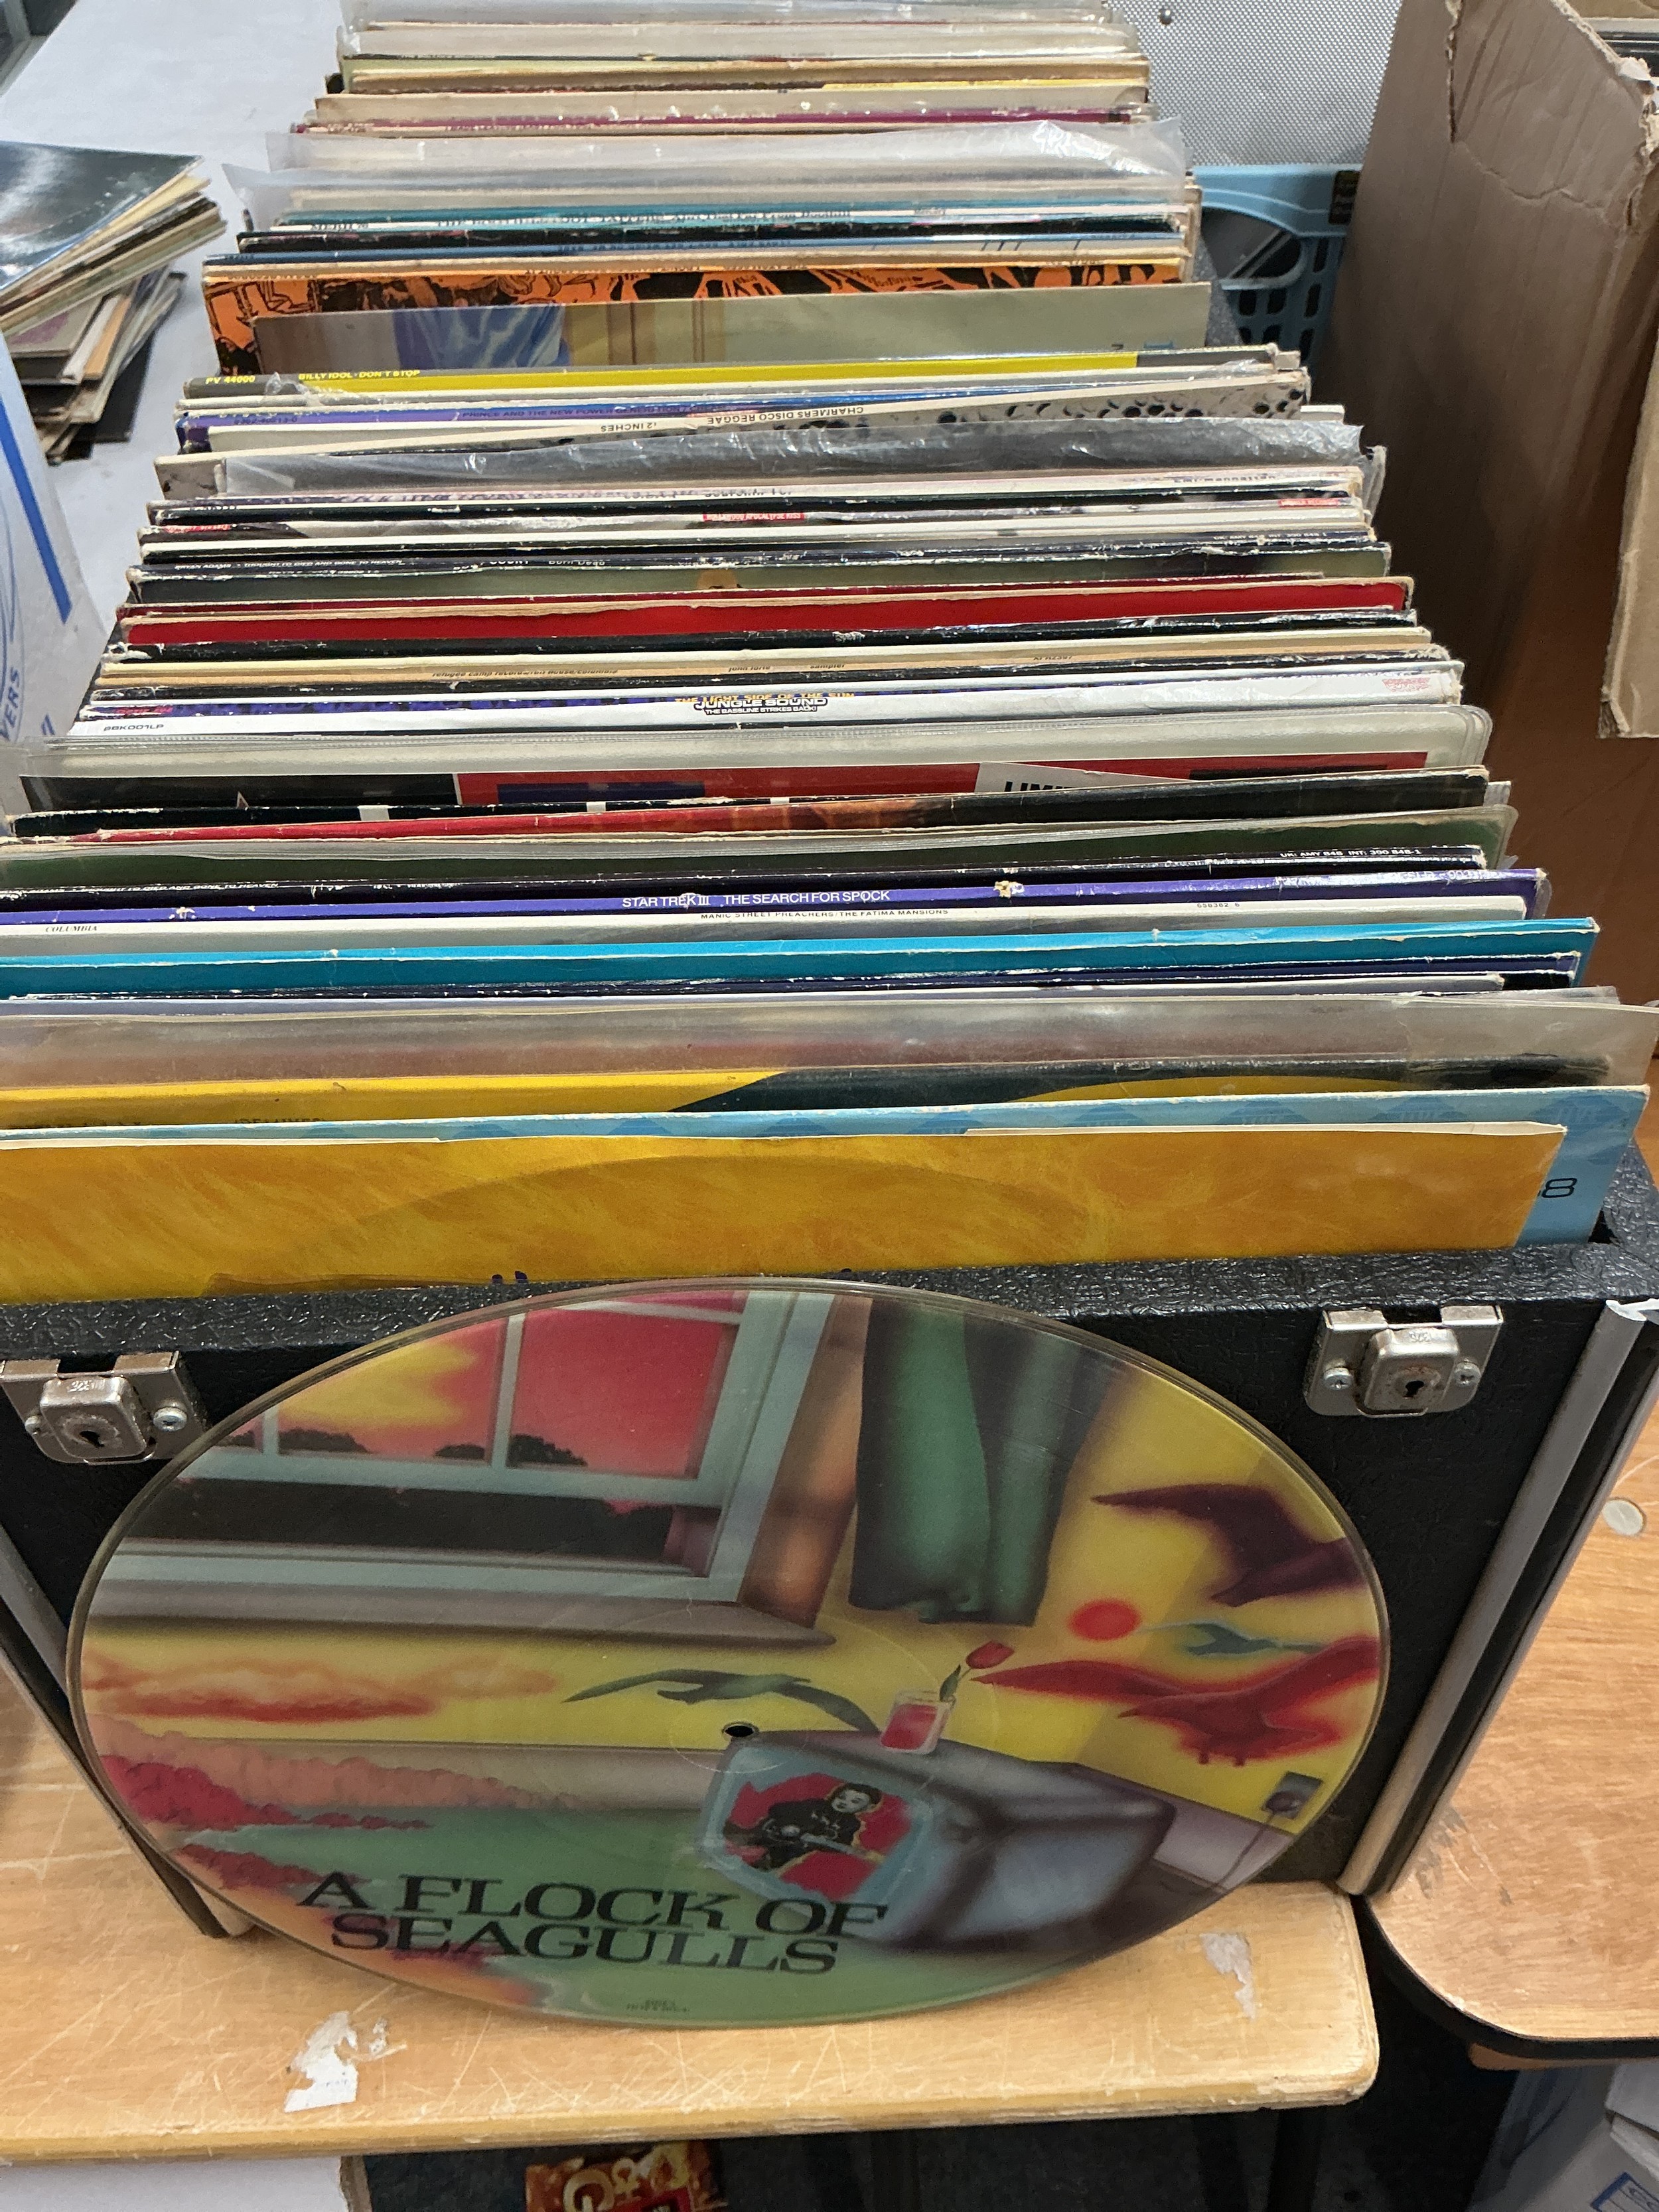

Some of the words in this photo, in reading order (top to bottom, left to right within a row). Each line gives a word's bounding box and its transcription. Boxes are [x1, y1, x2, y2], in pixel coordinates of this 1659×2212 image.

[798, 407, 864, 419] CHARMERS
[707, 415, 755, 425] REGGAE
[601, 422, 643, 432] INCHES
[695, 698, 763, 710] JUNGLE
[765, 697, 827, 707] SOUND
[622, 897, 658, 907] STAR
[658, 895, 696, 907] TREK
[698, 895, 711, 905] III
[723, 895, 751, 905] THE
[752, 893, 809, 904] SEARCH
[811, 891, 841, 903] FOR
[842, 890, 891, 902] SPOCK
[297, 1870, 371, 1910] A
[395, 1874, 745, 1931] FLOCK
[755, 1897, 888, 1939] OF
[330, 1913, 840, 1974] SEAGULLS
